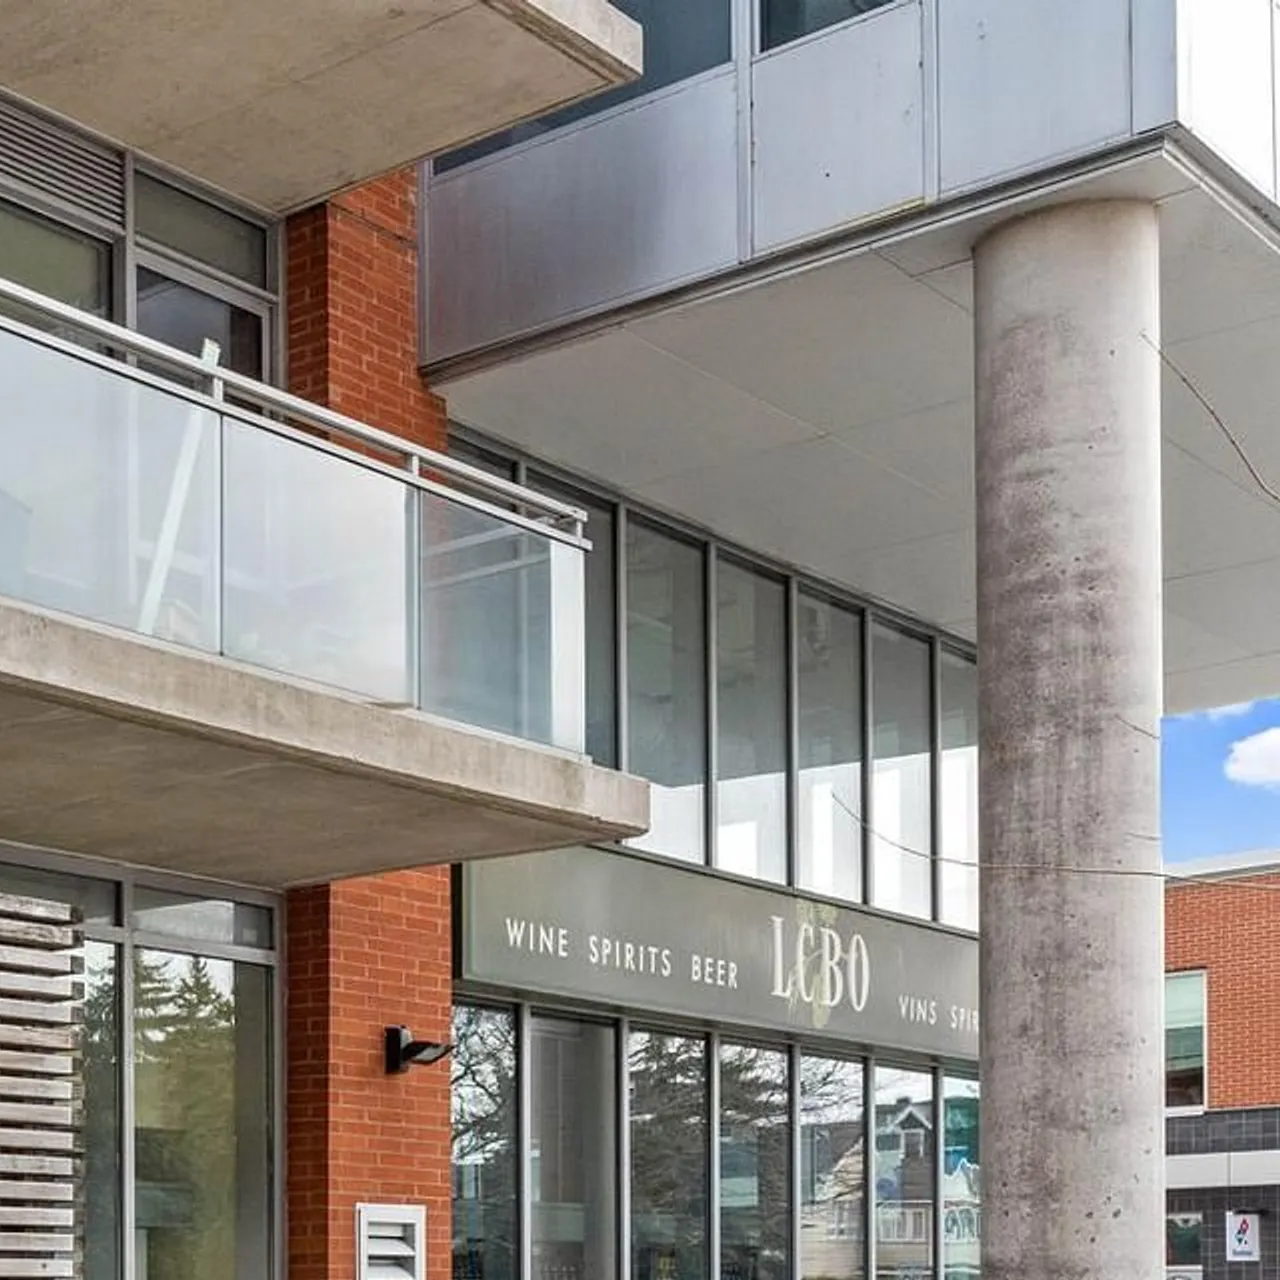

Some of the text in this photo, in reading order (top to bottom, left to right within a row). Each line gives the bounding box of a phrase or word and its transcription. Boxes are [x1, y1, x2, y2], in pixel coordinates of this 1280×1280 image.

[505, 916, 738, 989] WINE SPIRITS BEER
[770, 915, 870, 1012] LCBO
[898, 994, 938, 1026] VINS
